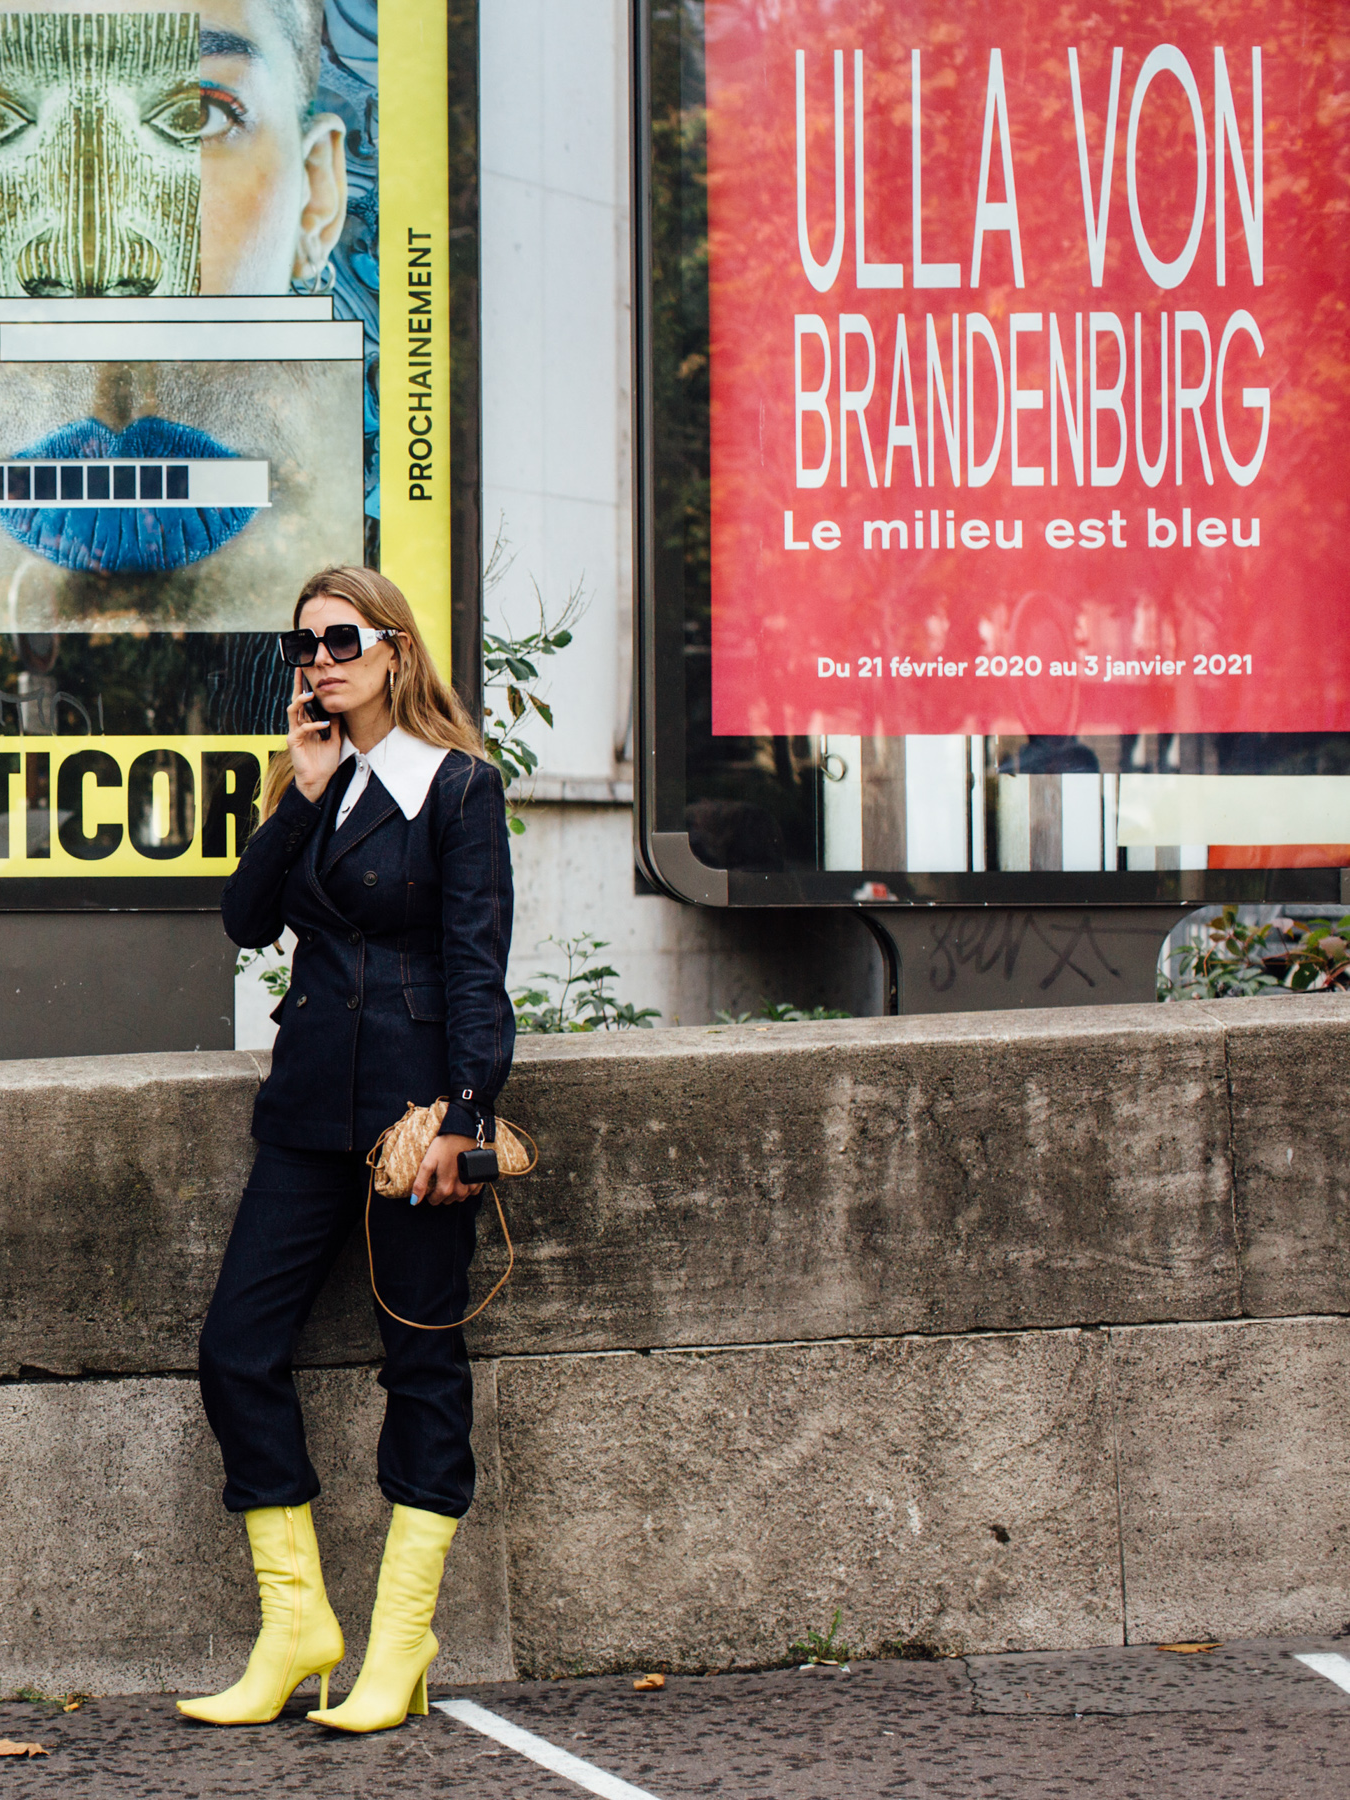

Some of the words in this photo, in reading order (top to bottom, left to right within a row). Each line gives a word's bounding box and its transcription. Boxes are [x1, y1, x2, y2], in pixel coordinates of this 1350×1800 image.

[795, 47, 1025, 293] ULLA
[1067, 43, 1264, 290] VON
[408, 227, 433, 502] PROCHAINEMENT
[794, 309, 1271, 489] BRANDENBURG
[783, 510, 842, 551] Le
[863, 509, 1023, 550] milieu
[1044, 510, 1127, 550] est
[1147, 508, 1261, 549] bleu
[817, 657, 850, 678] Du
[857, 657, 883, 678] 21
[889, 656, 968, 678] février
[974, 656, 1043, 678] 2020
[1048, 660, 1078, 677] au
[1083, 655, 1099, 677] 3
[1103, 655, 1186, 682] janvier
[1192, 653, 1253, 676] 2021
